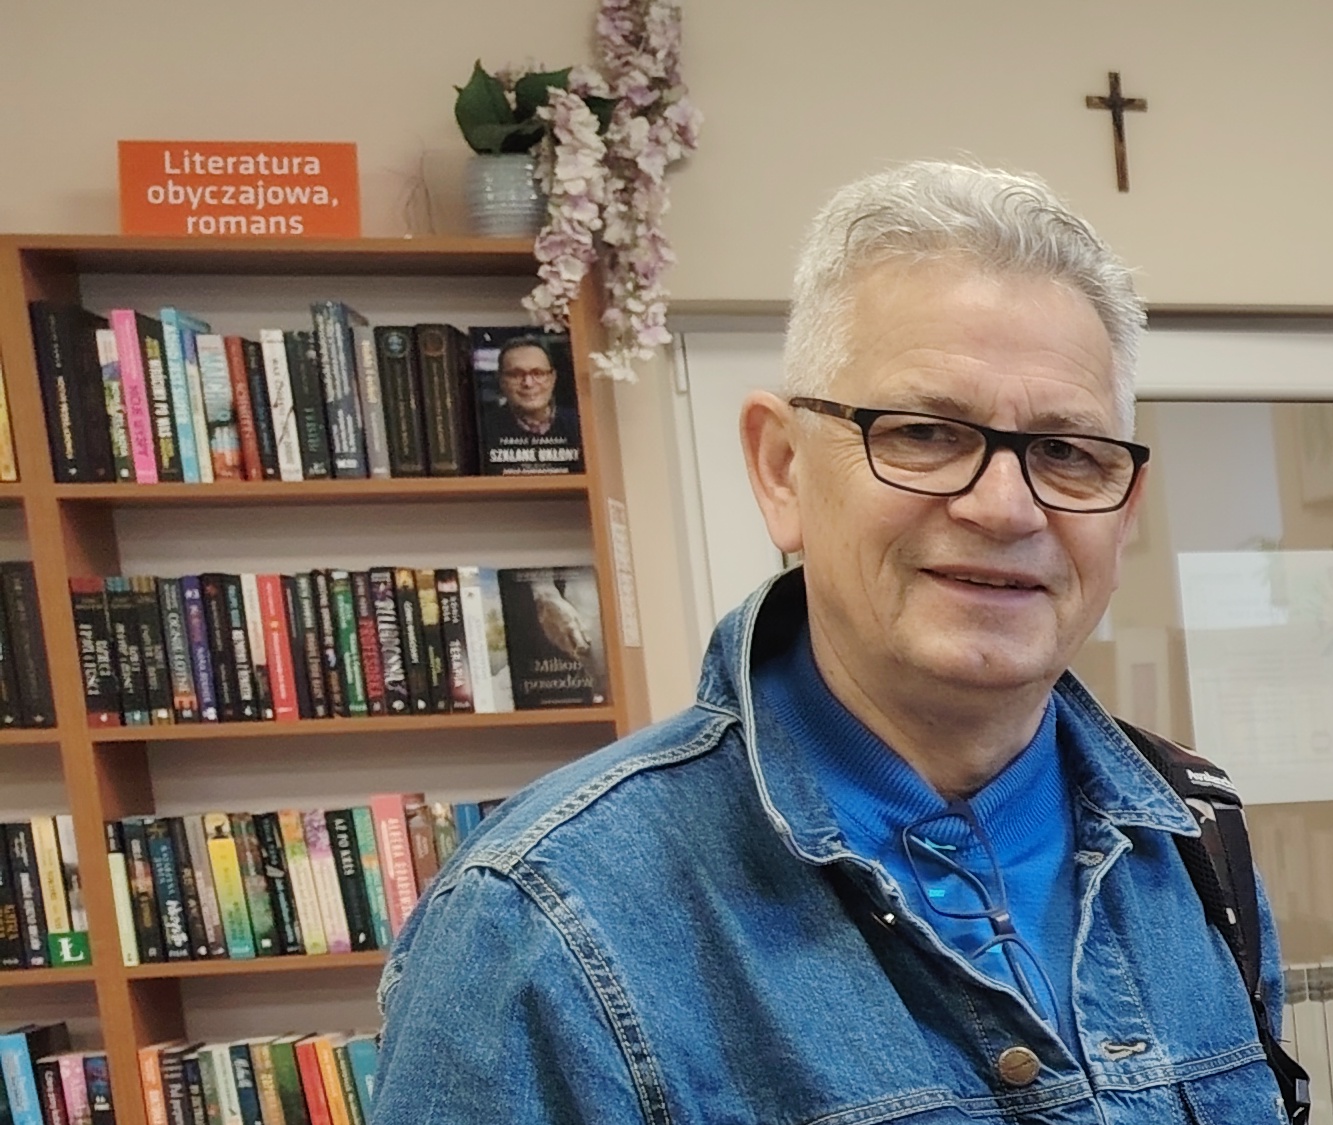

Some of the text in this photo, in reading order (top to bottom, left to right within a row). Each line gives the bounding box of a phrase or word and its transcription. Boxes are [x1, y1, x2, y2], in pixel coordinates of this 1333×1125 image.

[164, 150, 320, 174] Literatura
[147, 180, 338, 209] obyczajowa,
[187, 215, 304, 235] romans
[61, 937, 84, 962] Ł
